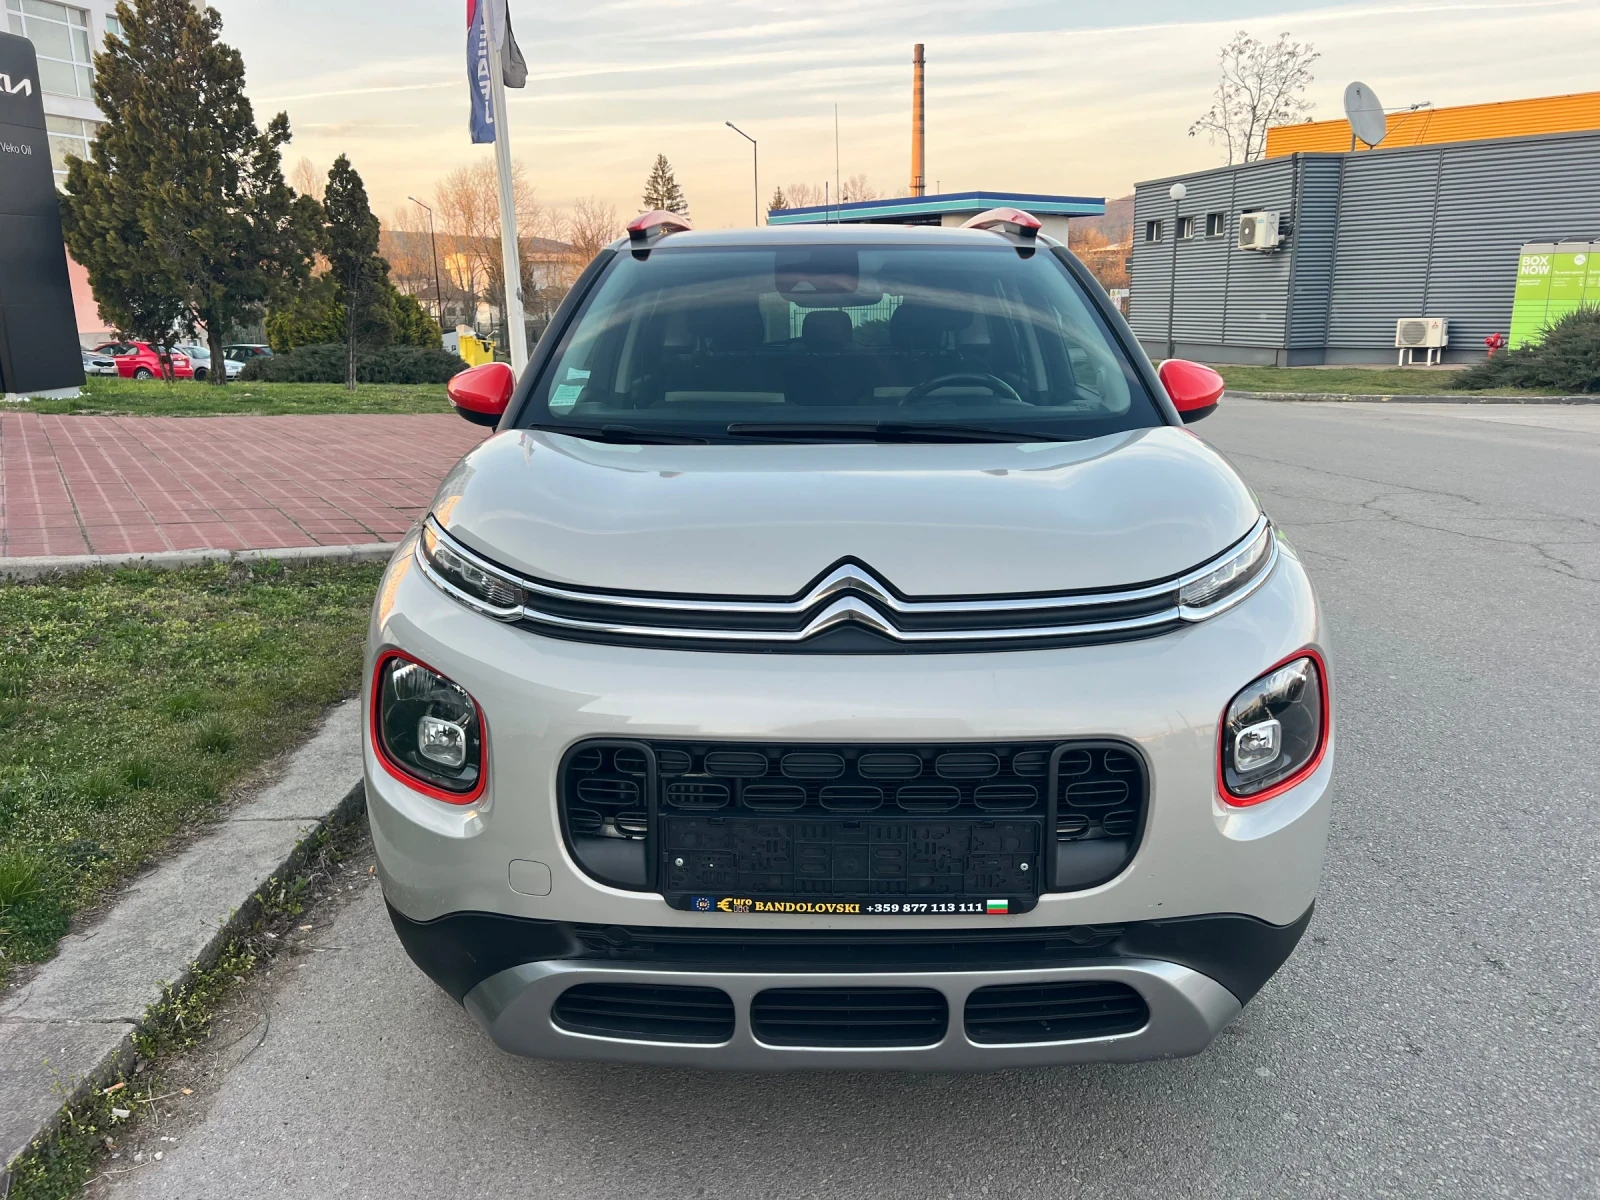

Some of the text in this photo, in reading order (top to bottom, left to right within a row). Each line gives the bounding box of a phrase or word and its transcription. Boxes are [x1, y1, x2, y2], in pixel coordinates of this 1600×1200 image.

[21, 144, 32, 156] Oil
[1522, 256, 1549, 265] BOX
[1521, 266, 1550, 275] NOW
[755, 901, 860, 913] BANDOLOVSKI
[866, 903, 899, 913] +359
[902, 903, 927, 912] 877
[931, 903, 956, 912] 113
[959, 903, 983, 912] 111
